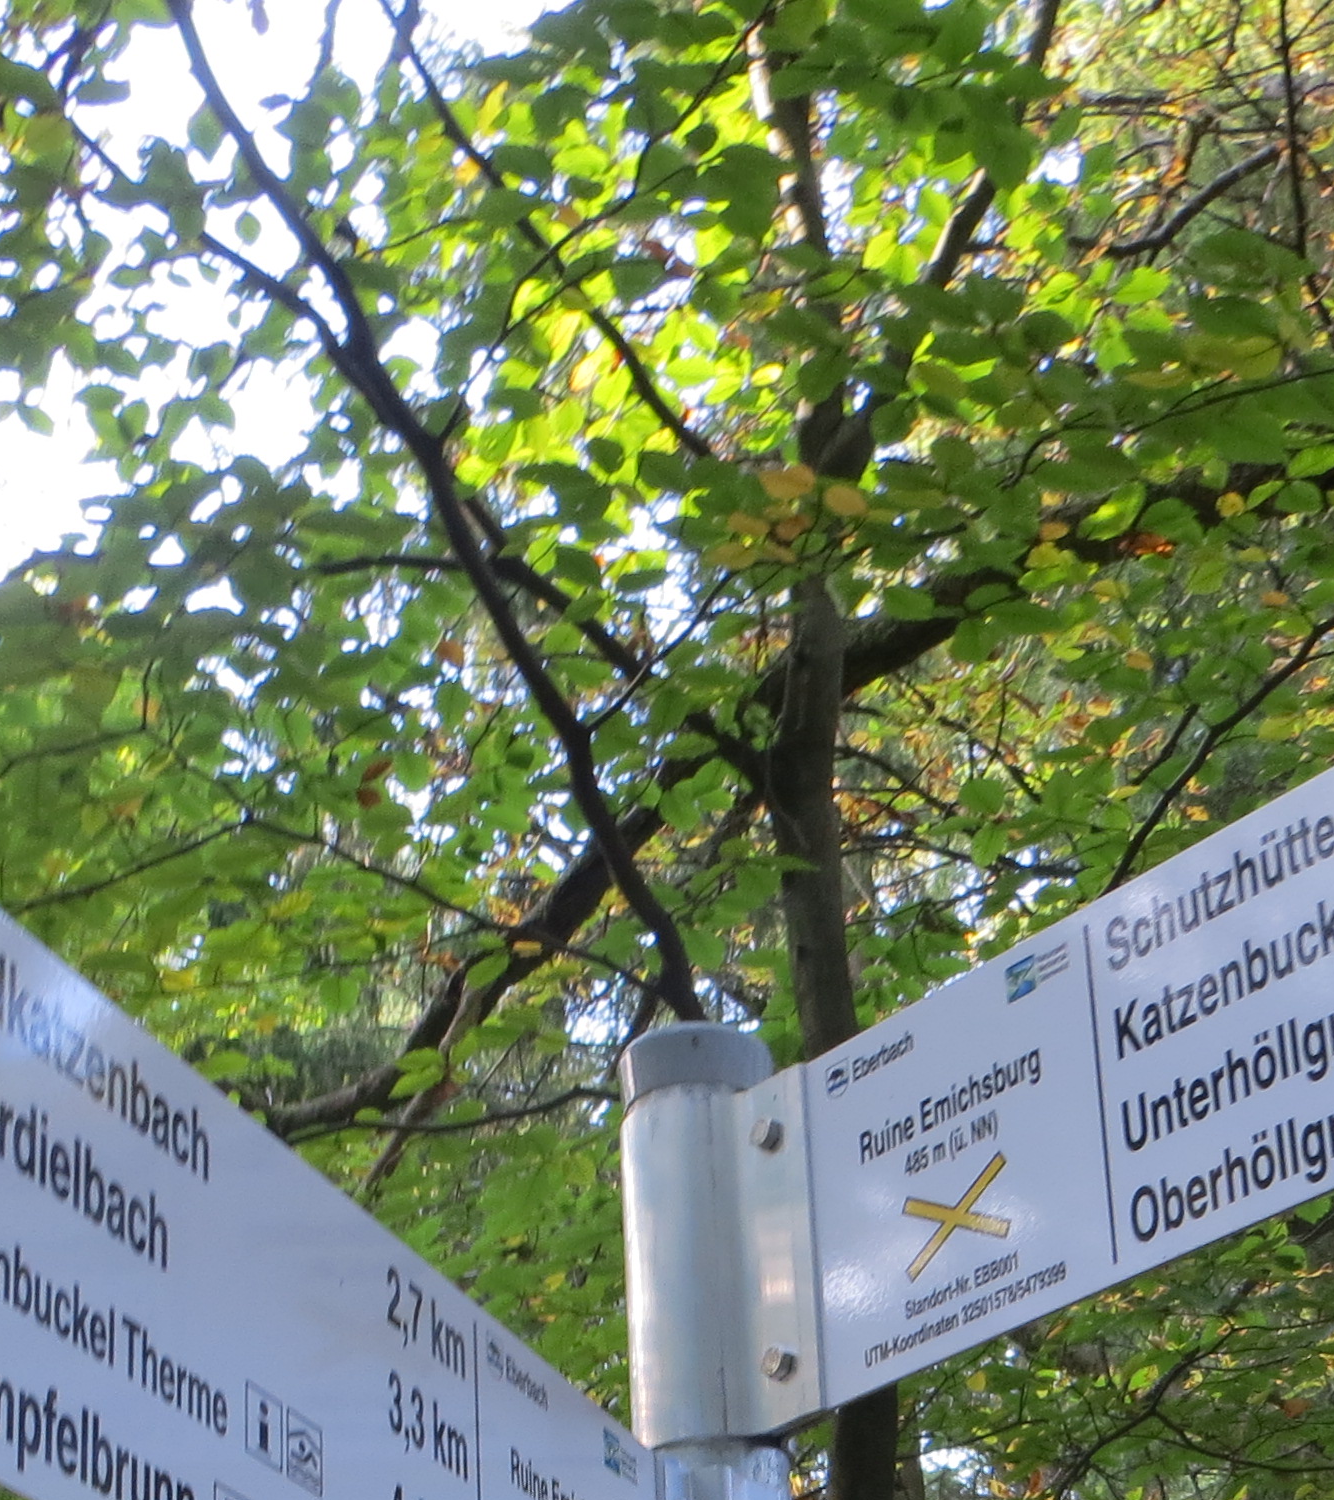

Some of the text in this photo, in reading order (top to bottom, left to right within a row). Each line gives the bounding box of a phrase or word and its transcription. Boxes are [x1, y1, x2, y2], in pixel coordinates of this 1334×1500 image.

[852, 1030, 914, 1083] Eberbach
[859, 1047, 1041, 1165] Ruine Emichsburg
[904, 1145, 929, 1176] 485
[932, 1142, 946, 1163] m
[971, 1109, 999, 1145] NN)
[387, 1265, 465, 1380] 2,7 km
[905, 1250, 1019, 1320] Standort-Nr. EBB001
[122, 1315, 228, 1436] Therme
[865, 1312, 959, 1368] UTM-Koordinaten
[389, 1369, 468, 1481] 3,3 km
